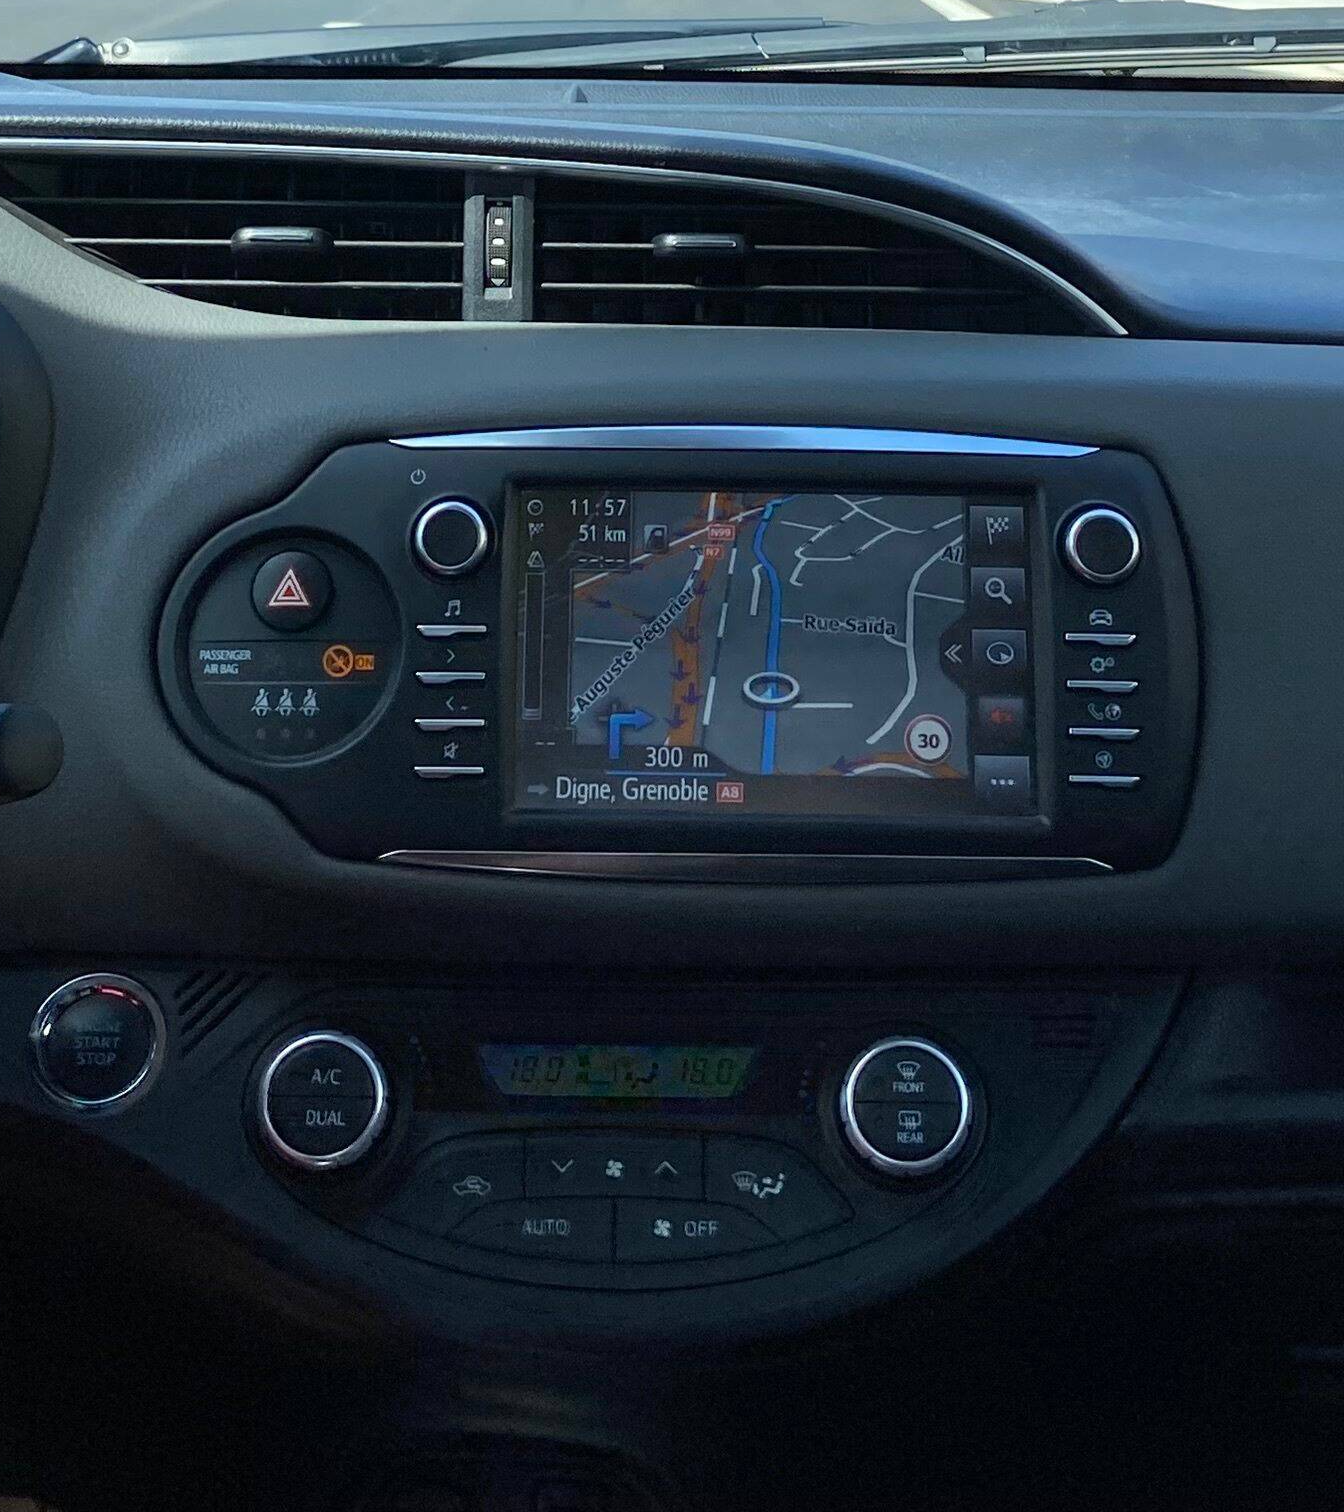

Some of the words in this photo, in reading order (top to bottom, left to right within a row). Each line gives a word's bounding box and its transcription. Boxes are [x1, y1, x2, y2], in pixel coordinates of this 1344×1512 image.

[569, 498, 628, 517] 11:57
[578, 524, 597, 542] 51
[604, 524, 626, 542] km
[805, 614, 840, 631] Rue
[845, 615, 897, 635] Saïda
[199, 649, 252, 661] PASSENGER
[575, 649, 636, 712] Auguste
[632, 587, 697, 651] Pégurier
[203, 663, 219, 675] AIR
[220, 664, 239, 675] BAG
[355, 656, 373, 669] ON
[918, 733, 940, 749] 30
[644, 746, 683, 768] 300
[693, 751, 709, 768] m
[555, 776, 616, 805] Digne,
[622, 776, 709, 802] Grenoble
[720, 786, 739, 799] A8
[73, 1036, 121, 1049] START
[77, 1051, 118, 1065] STOP
[310, 1068, 342, 1086] A/C
[892, 1081, 926, 1093] FRONT
[305, 1108, 346, 1126] DUAL
[896, 1131, 924, 1144] REAR
[522, 1218, 570, 1236] AUTO
[684, 1220, 720, 1238] OFF
